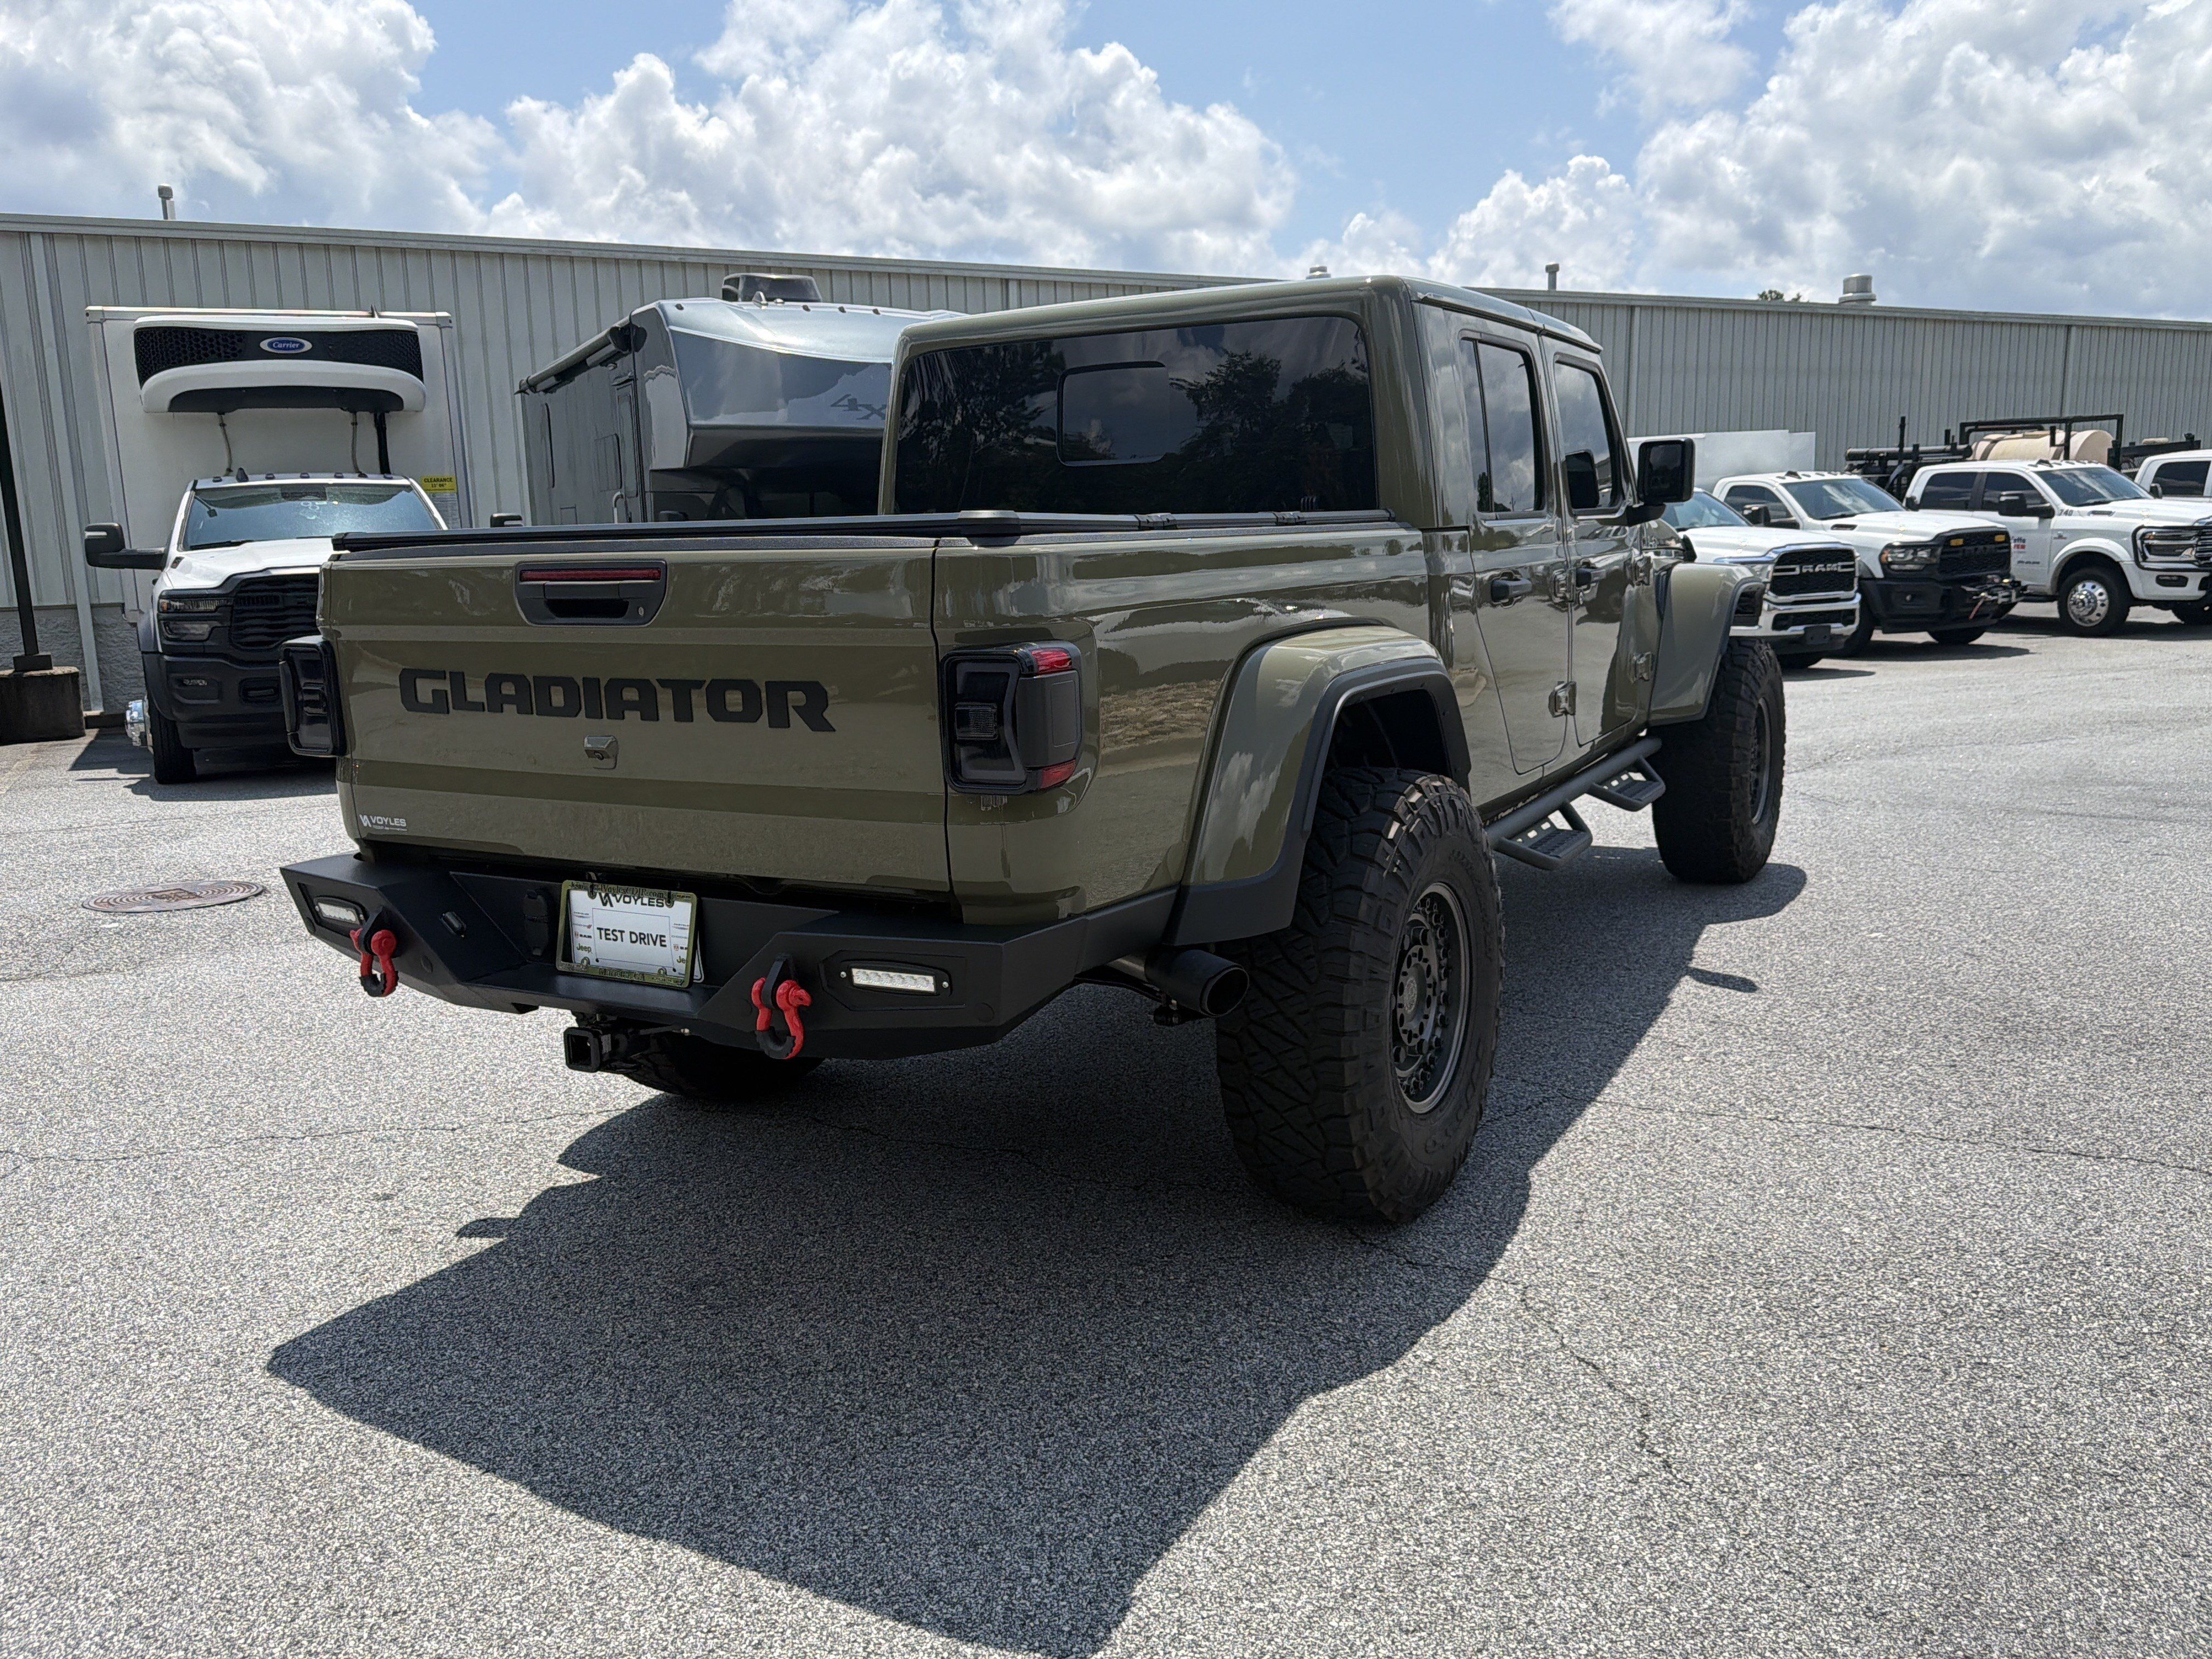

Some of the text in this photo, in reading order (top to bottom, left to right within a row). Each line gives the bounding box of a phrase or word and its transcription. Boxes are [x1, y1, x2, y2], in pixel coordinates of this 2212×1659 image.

[1802, 563, 1838, 573] RAM
[398, 668, 837, 732] GLADIATOR
[370, 815, 407, 827] VOYLES
[612, 893, 664, 907] VOYLES
[596, 927, 667, 947] TEST DRIVE
[576, 943, 592, 953] Jeep
